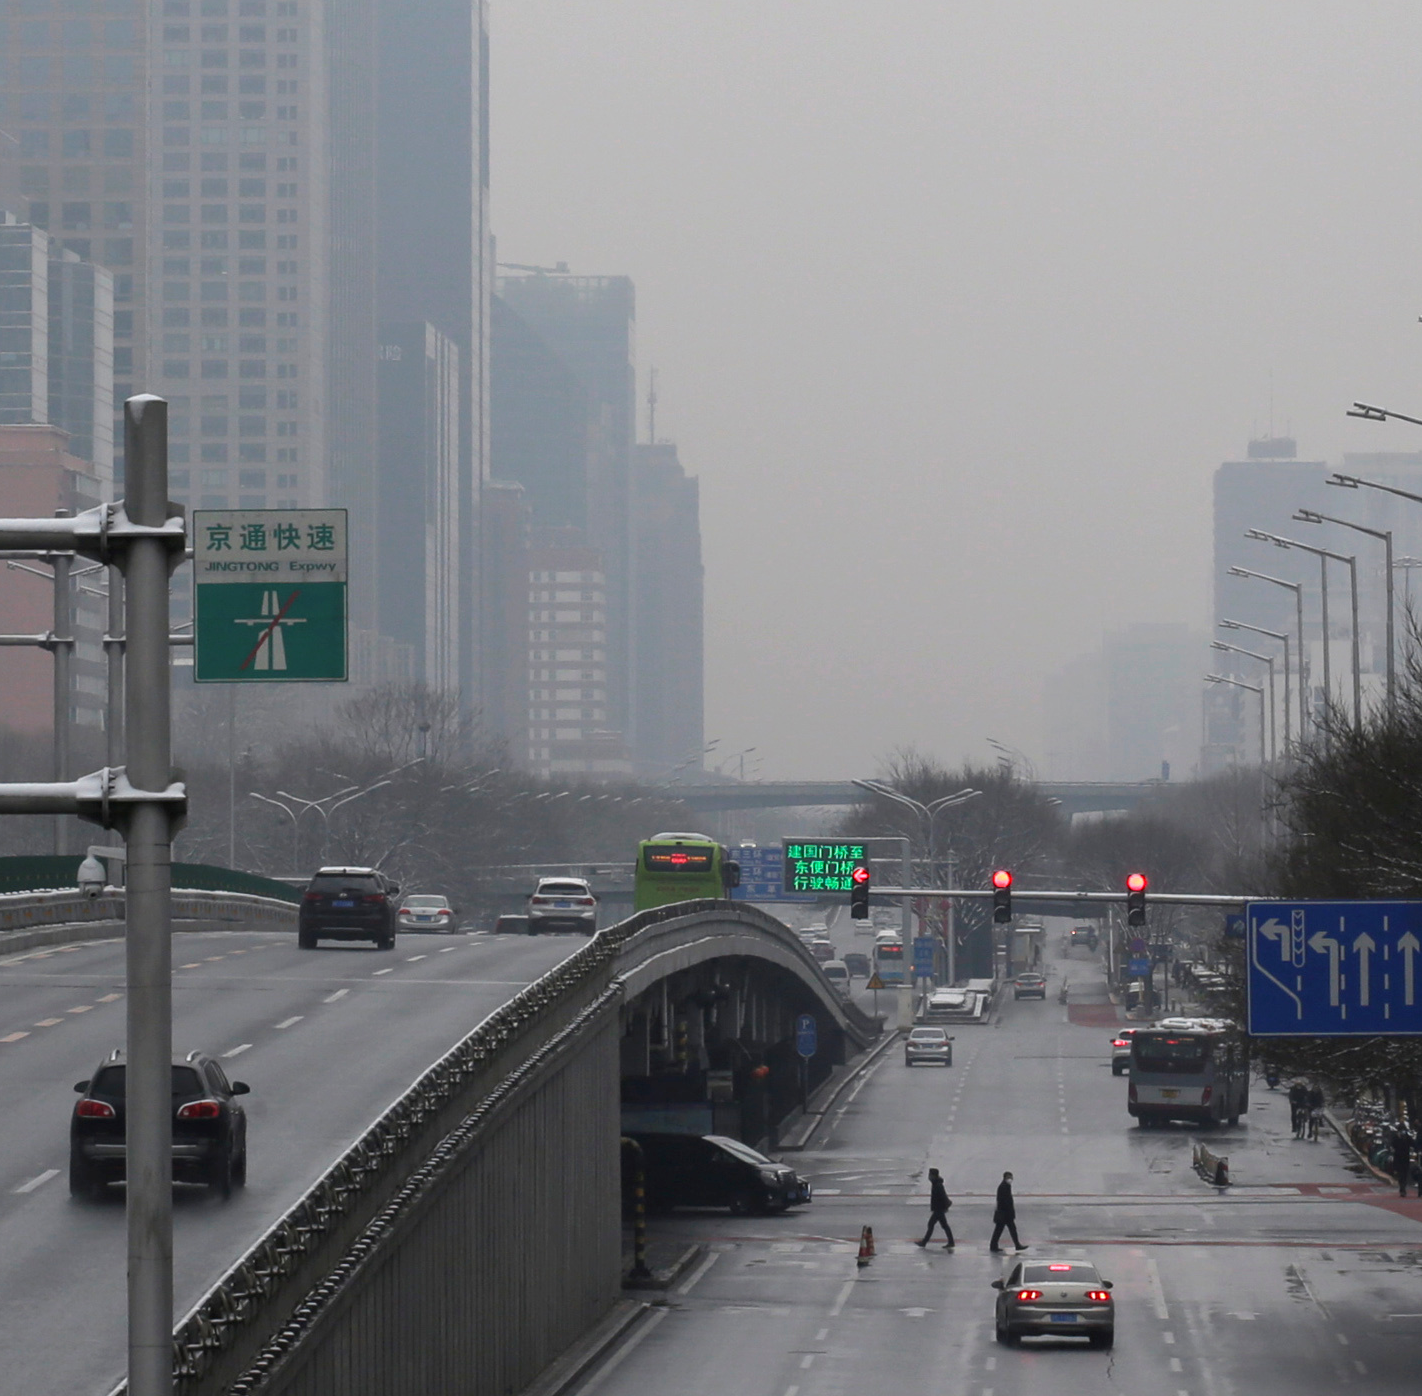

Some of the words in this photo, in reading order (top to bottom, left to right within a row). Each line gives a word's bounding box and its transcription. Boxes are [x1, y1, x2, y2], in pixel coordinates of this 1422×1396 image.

[206, 523, 335, 551] 京通快速
[205, 561, 280, 572] JINGTONG
[289, 561, 336, 572] Expwy
[787, 845, 864, 859] 建国门桥至
[795, 860, 855, 874] 东便门桥
[794, 876, 854, 890] 行驶畅通
